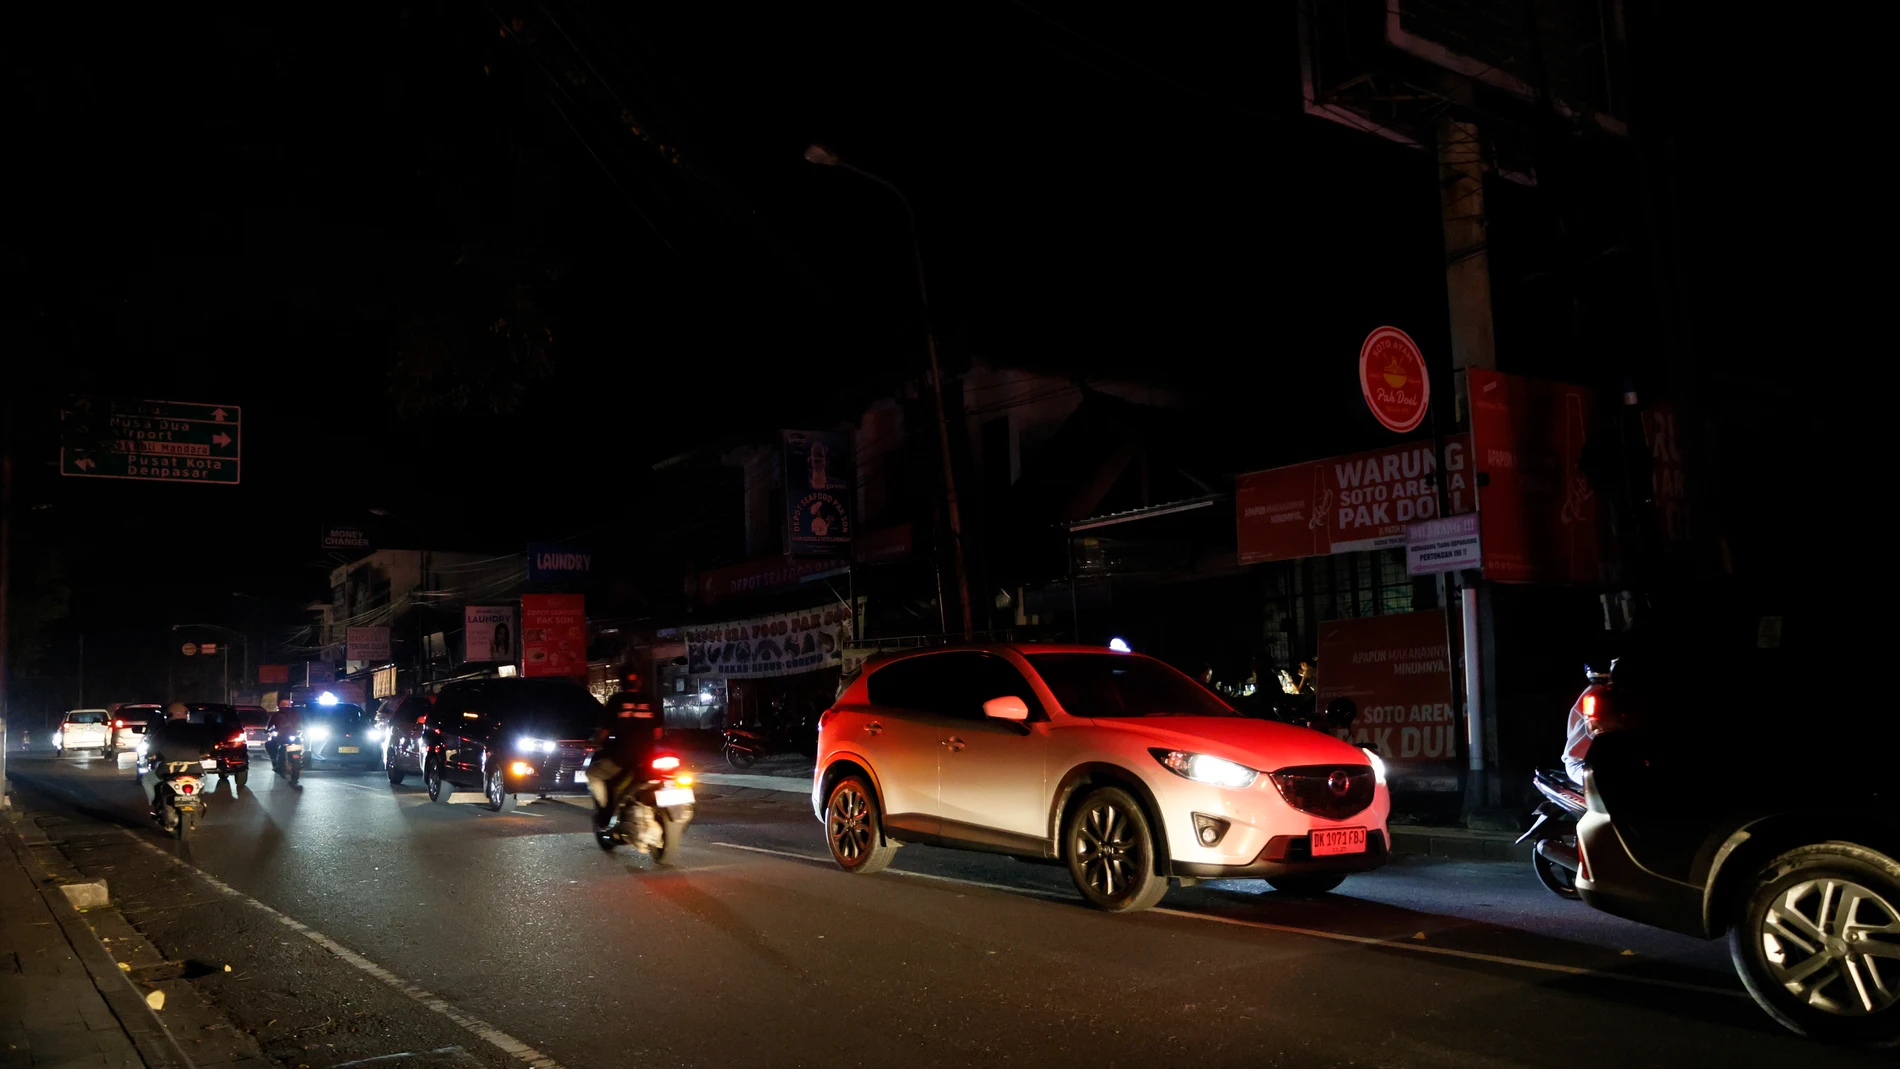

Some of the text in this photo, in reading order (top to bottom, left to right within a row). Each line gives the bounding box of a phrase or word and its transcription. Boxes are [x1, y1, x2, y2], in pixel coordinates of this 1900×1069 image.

[1372, 340, 1413, 362] SOTO AYAM
[1376, 387, 1417, 406] Pak Doel
[160, 421, 190, 431] Dua
[161, 444, 207, 454] Mandara
[128, 455, 222, 469] Pusat Kota
[1335, 442, 1464, 489] WARUNG
[128, 465, 208, 478] Denpasar
[1339, 485, 1388, 507] SOTO
[792, 492, 849, 533] DEPOT SEAFOOD PAK SON
[1338, 505, 1391, 529] PAK
[1396, 491, 1468, 522] DOL
[325, 537, 369, 546] CHANGER
[330, 529, 364, 538] MONEY
[537, 552, 591, 571] LAUNDRY
[1419, 550, 1452, 561] PERTOKOAN
[731, 573, 761, 592] DEPOT
[468, 615, 511, 623] LAUNDRY
[752, 620, 788, 639] FOOD
[791, 614, 821, 632] PAK
[786, 654, 823, 669] GORENG
[1352, 648, 1386, 664] APAPUN
[1364, 705, 1405, 723] SOTO
[1314, 830, 1364, 847] DK 1971 FBJ
